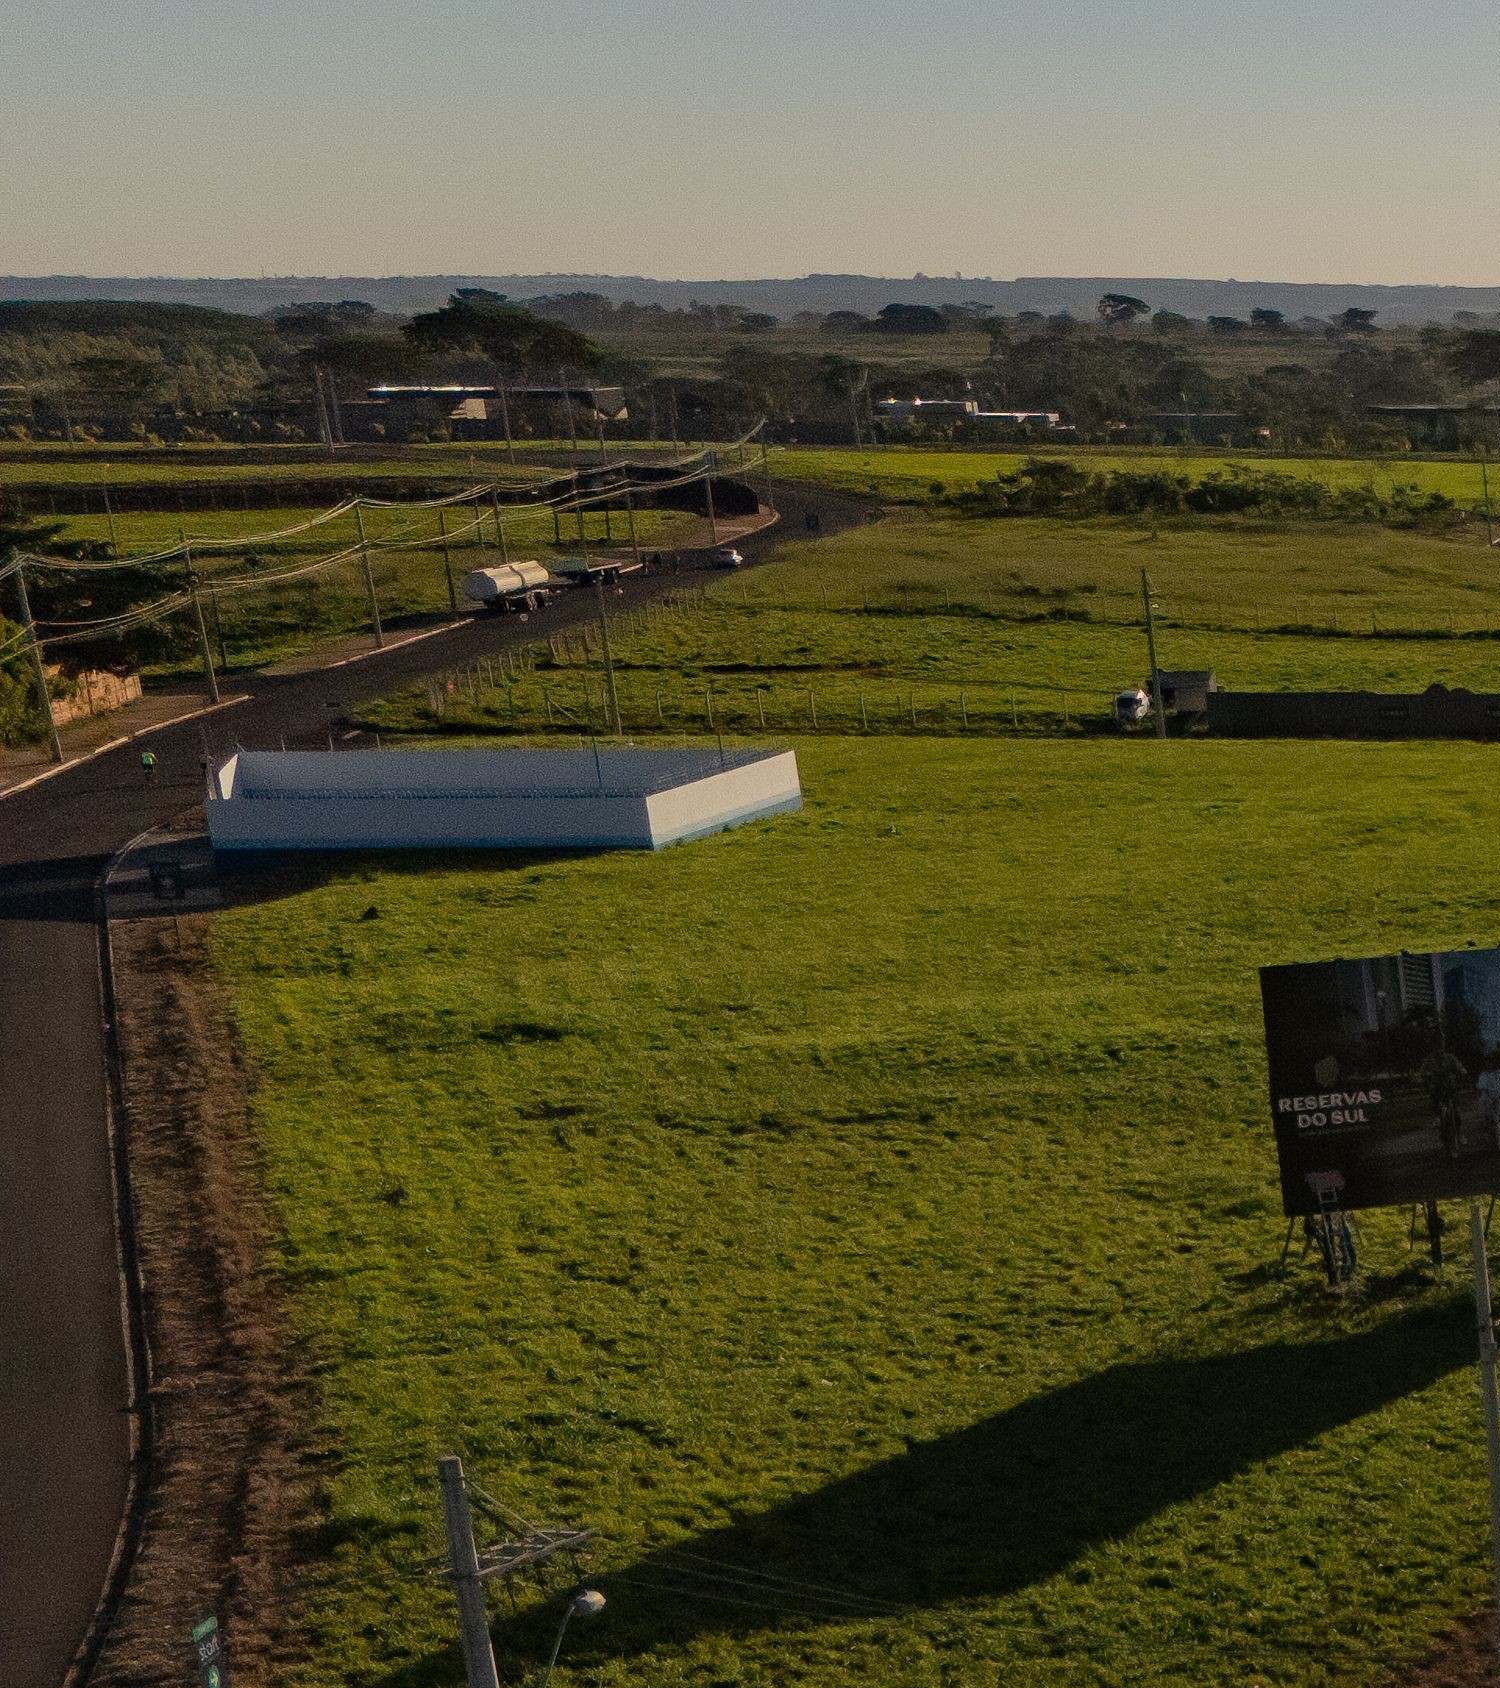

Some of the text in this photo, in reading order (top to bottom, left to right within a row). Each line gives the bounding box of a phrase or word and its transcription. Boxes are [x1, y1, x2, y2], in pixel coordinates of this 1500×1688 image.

[1278, 1089, 1382, 1113] RESERVAS
[1296, 1107, 1369, 1129] DO SUL
